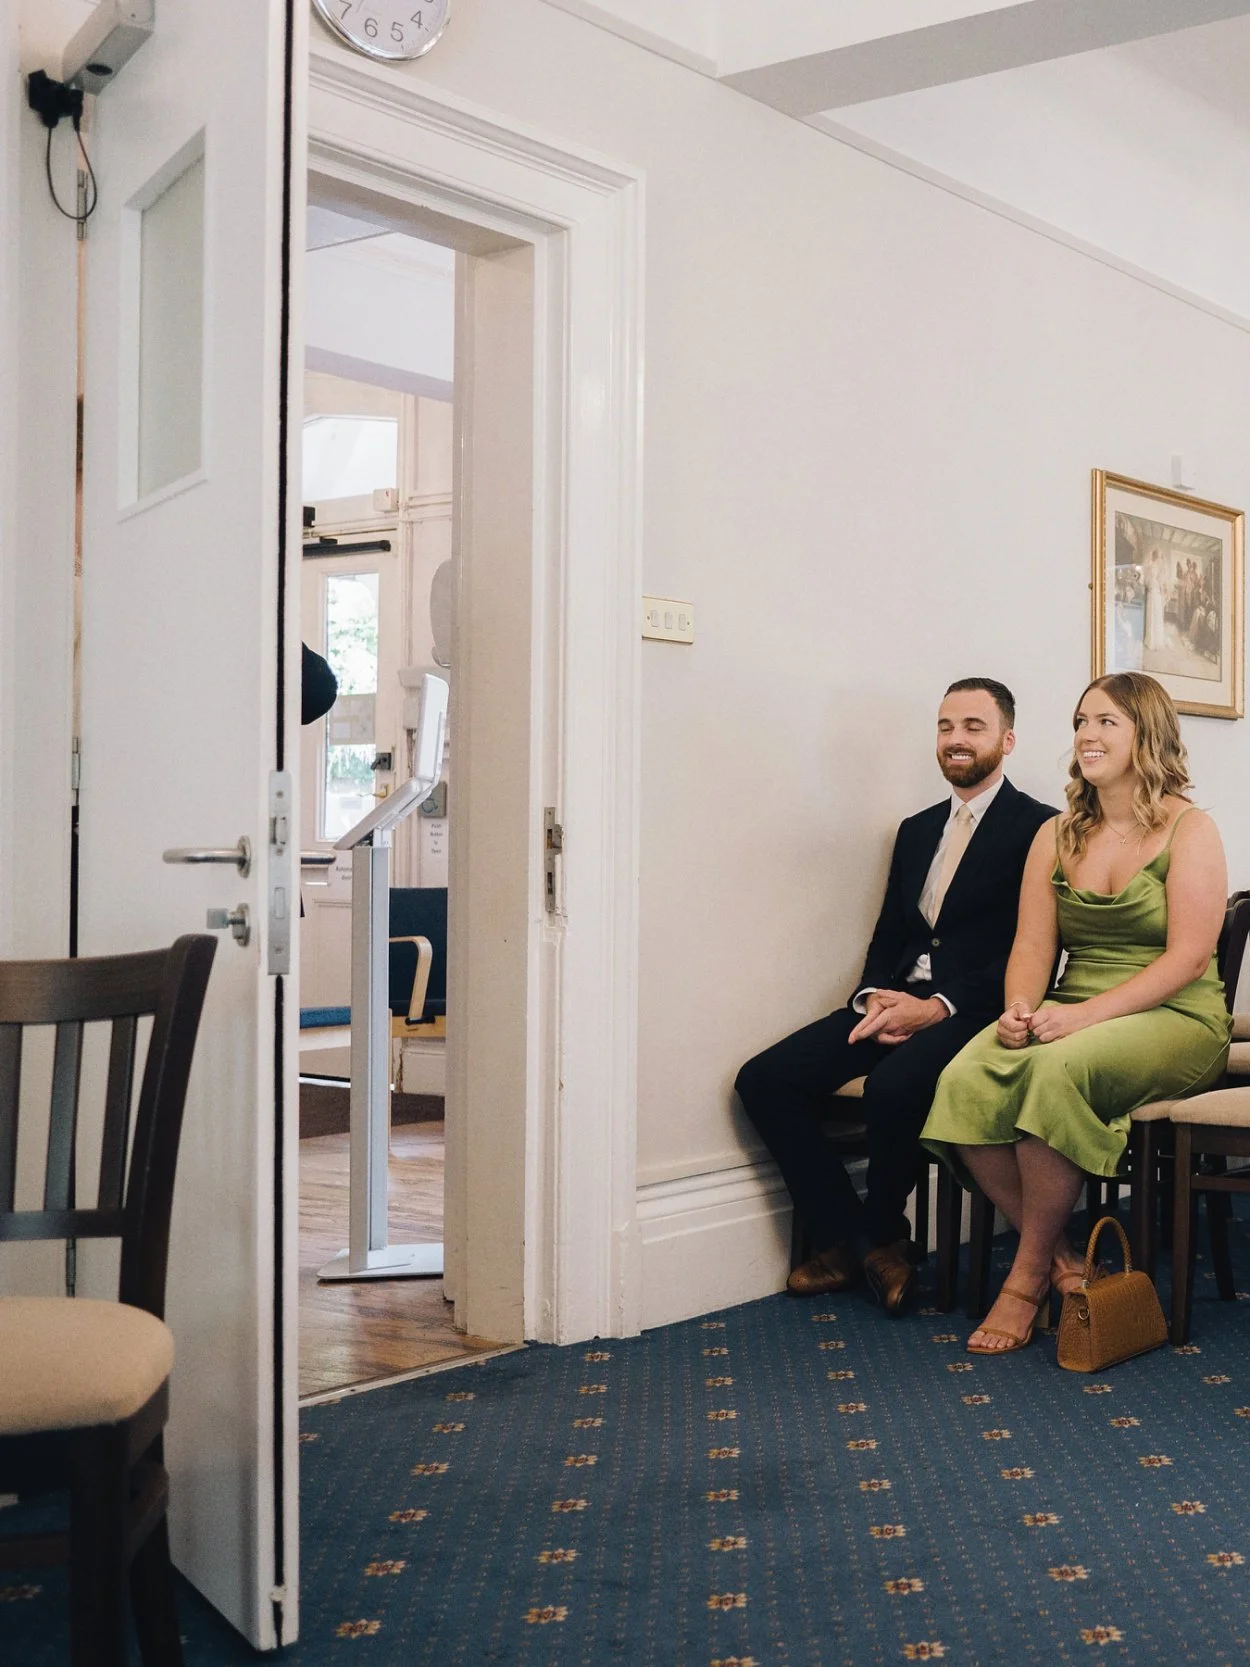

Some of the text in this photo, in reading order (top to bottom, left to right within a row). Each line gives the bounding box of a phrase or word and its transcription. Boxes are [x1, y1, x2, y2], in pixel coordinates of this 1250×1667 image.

[339, 0, 352, 20] 7
[410, 10, 423, 29] 4
[364, 17, 378, 38] 6
[390, 21, 404, 42] 5
